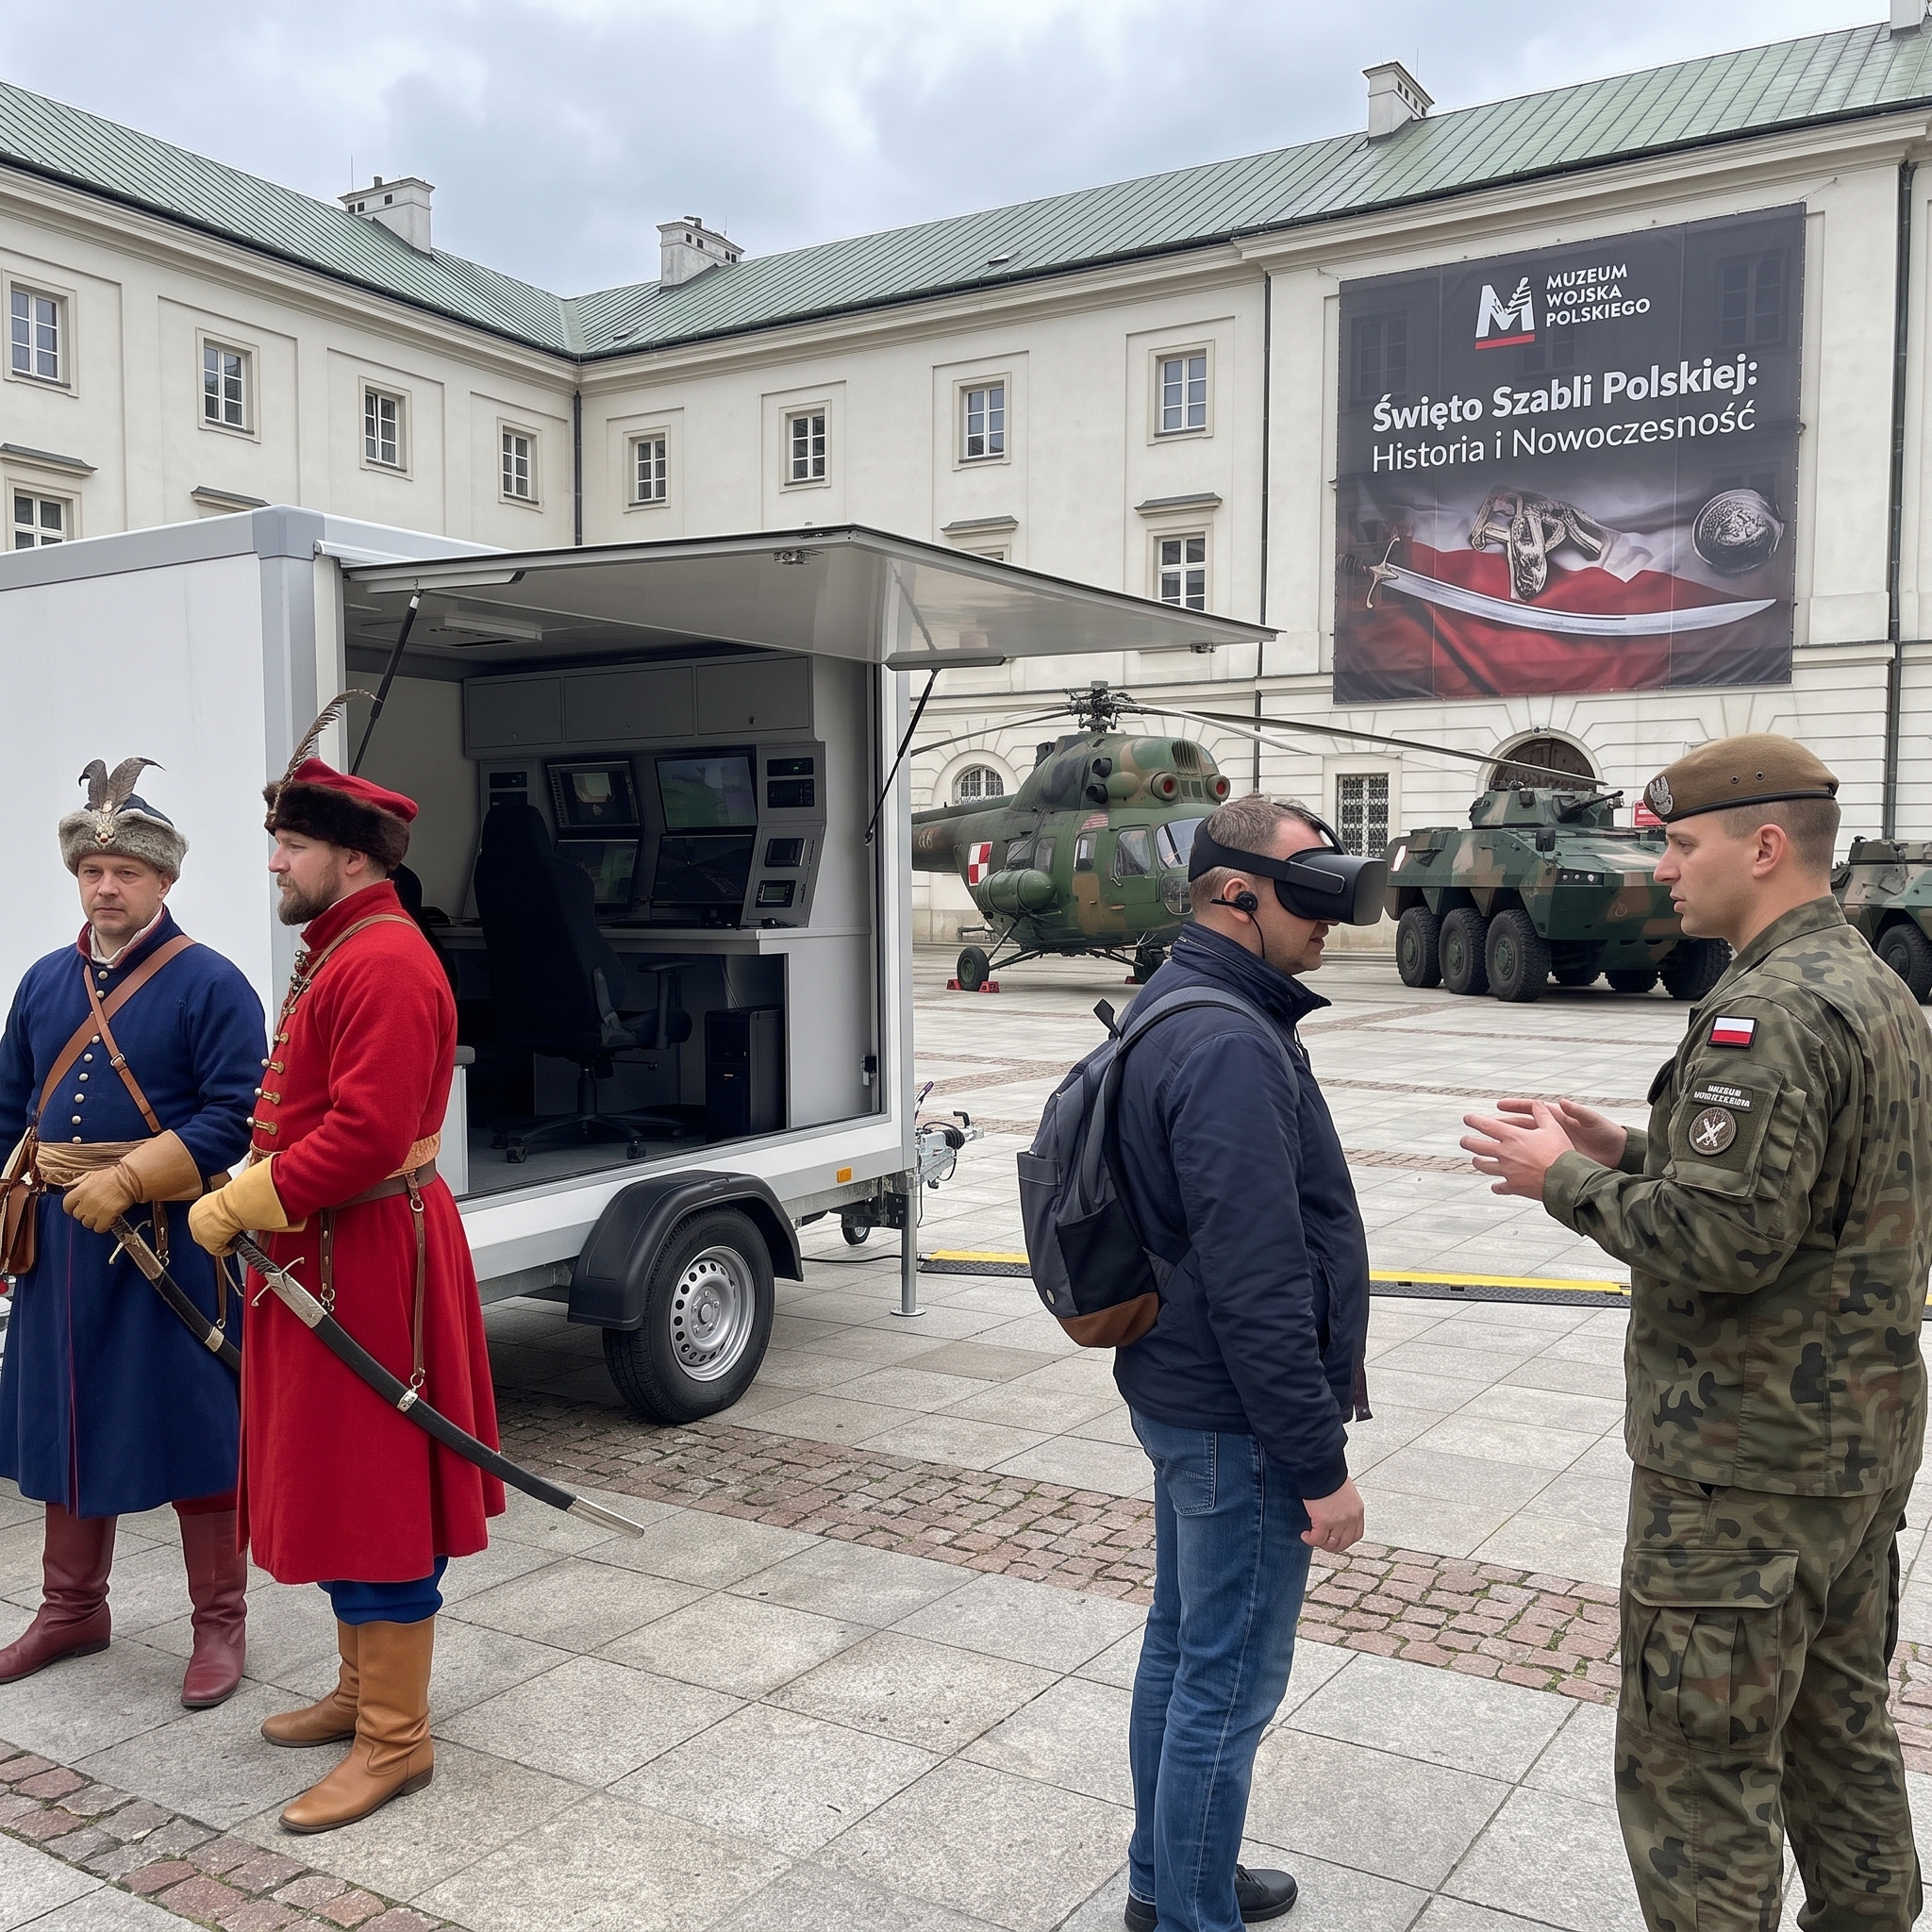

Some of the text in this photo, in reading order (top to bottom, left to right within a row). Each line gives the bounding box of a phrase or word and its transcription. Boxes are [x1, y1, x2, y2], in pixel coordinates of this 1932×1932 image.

[1546, 263, 1627, 290] MUZEUM
[1546, 284, 1623, 308] WOJSKA
[1546, 298, 1651, 327] POLSKIEGO
[1373, 353, 1757, 432] Święto Szabli Polskiej:
[1373, 399, 1756, 473] Historia i Nowoczesność
